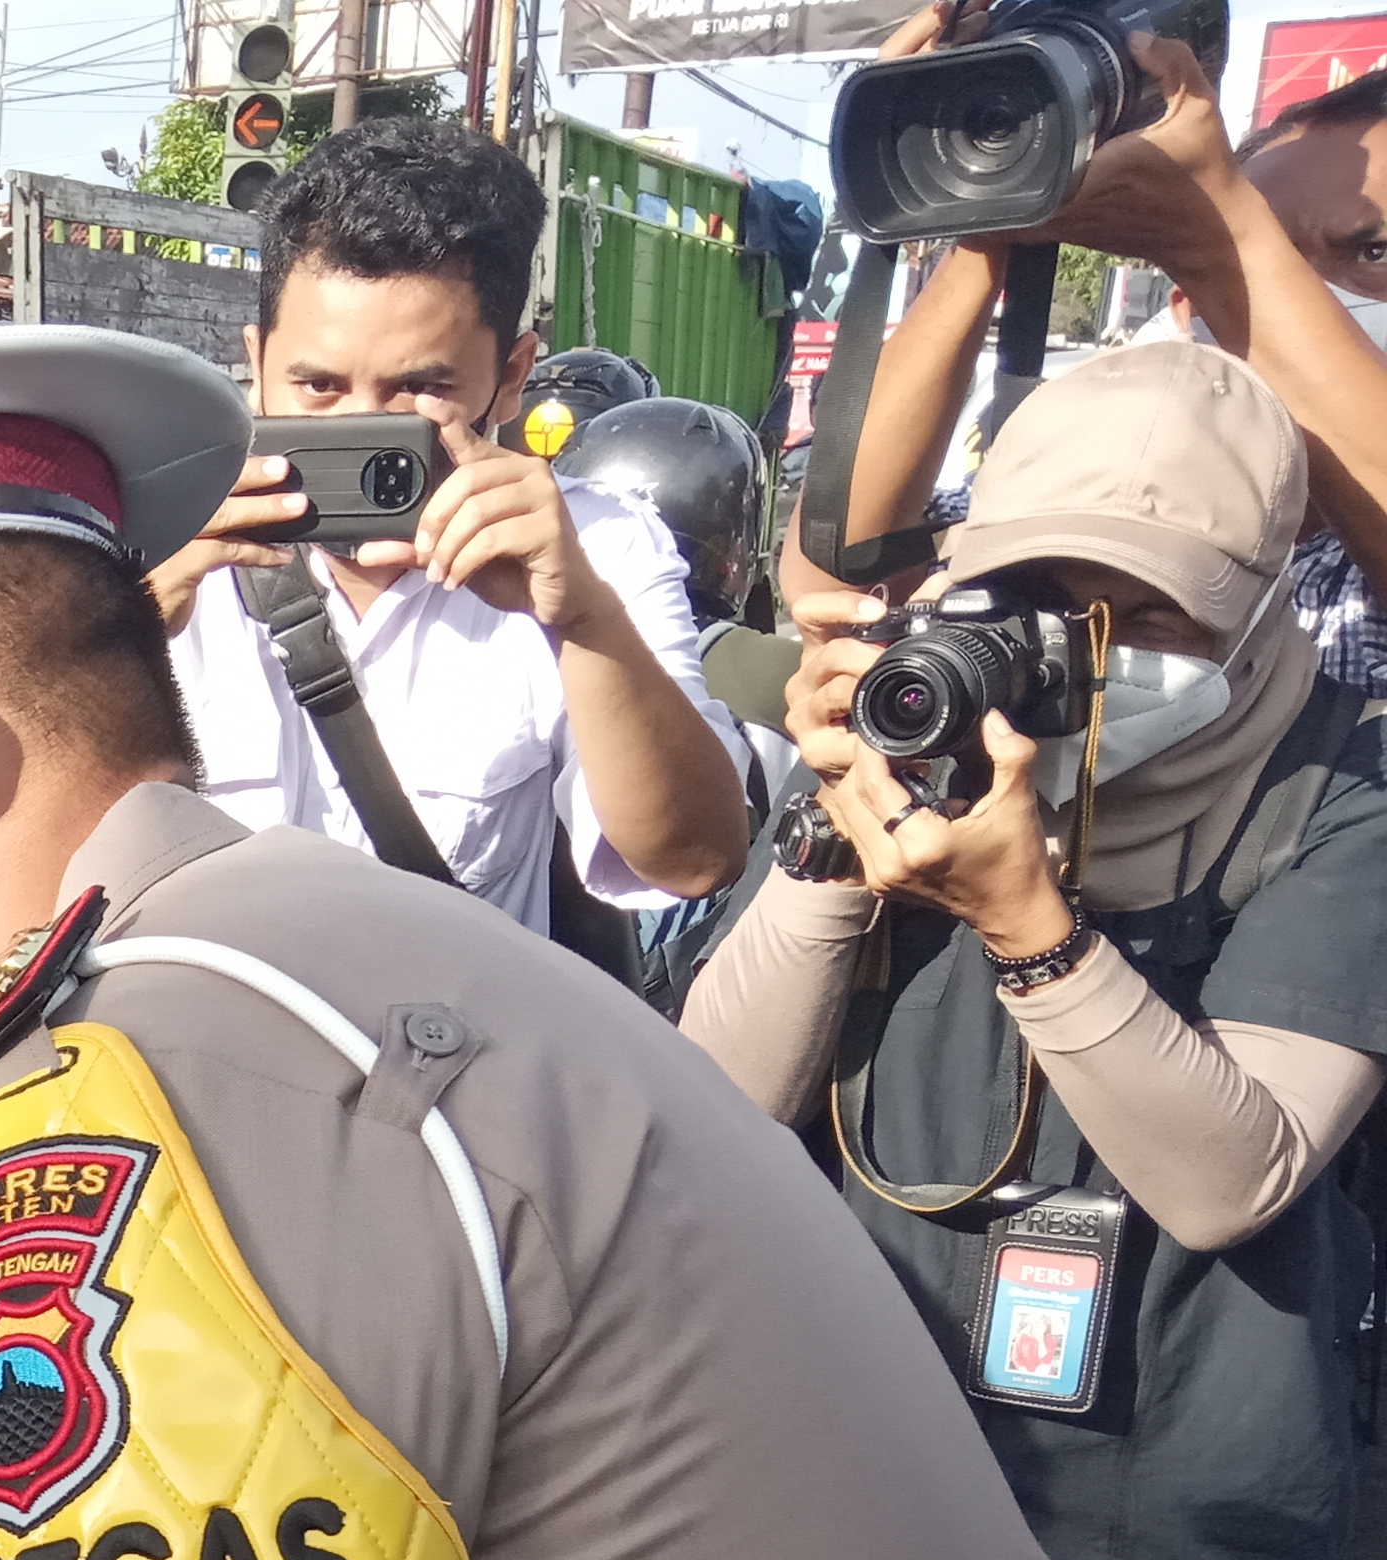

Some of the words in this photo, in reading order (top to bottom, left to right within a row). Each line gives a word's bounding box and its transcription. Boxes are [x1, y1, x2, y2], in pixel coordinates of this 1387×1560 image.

[692, 17, 739, 35] KETUA
[774, 12, 789, 28] RI
[1007, 1206, 1101, 1238] PRESS
[1020, 1265, 1076, 1287] PERS
